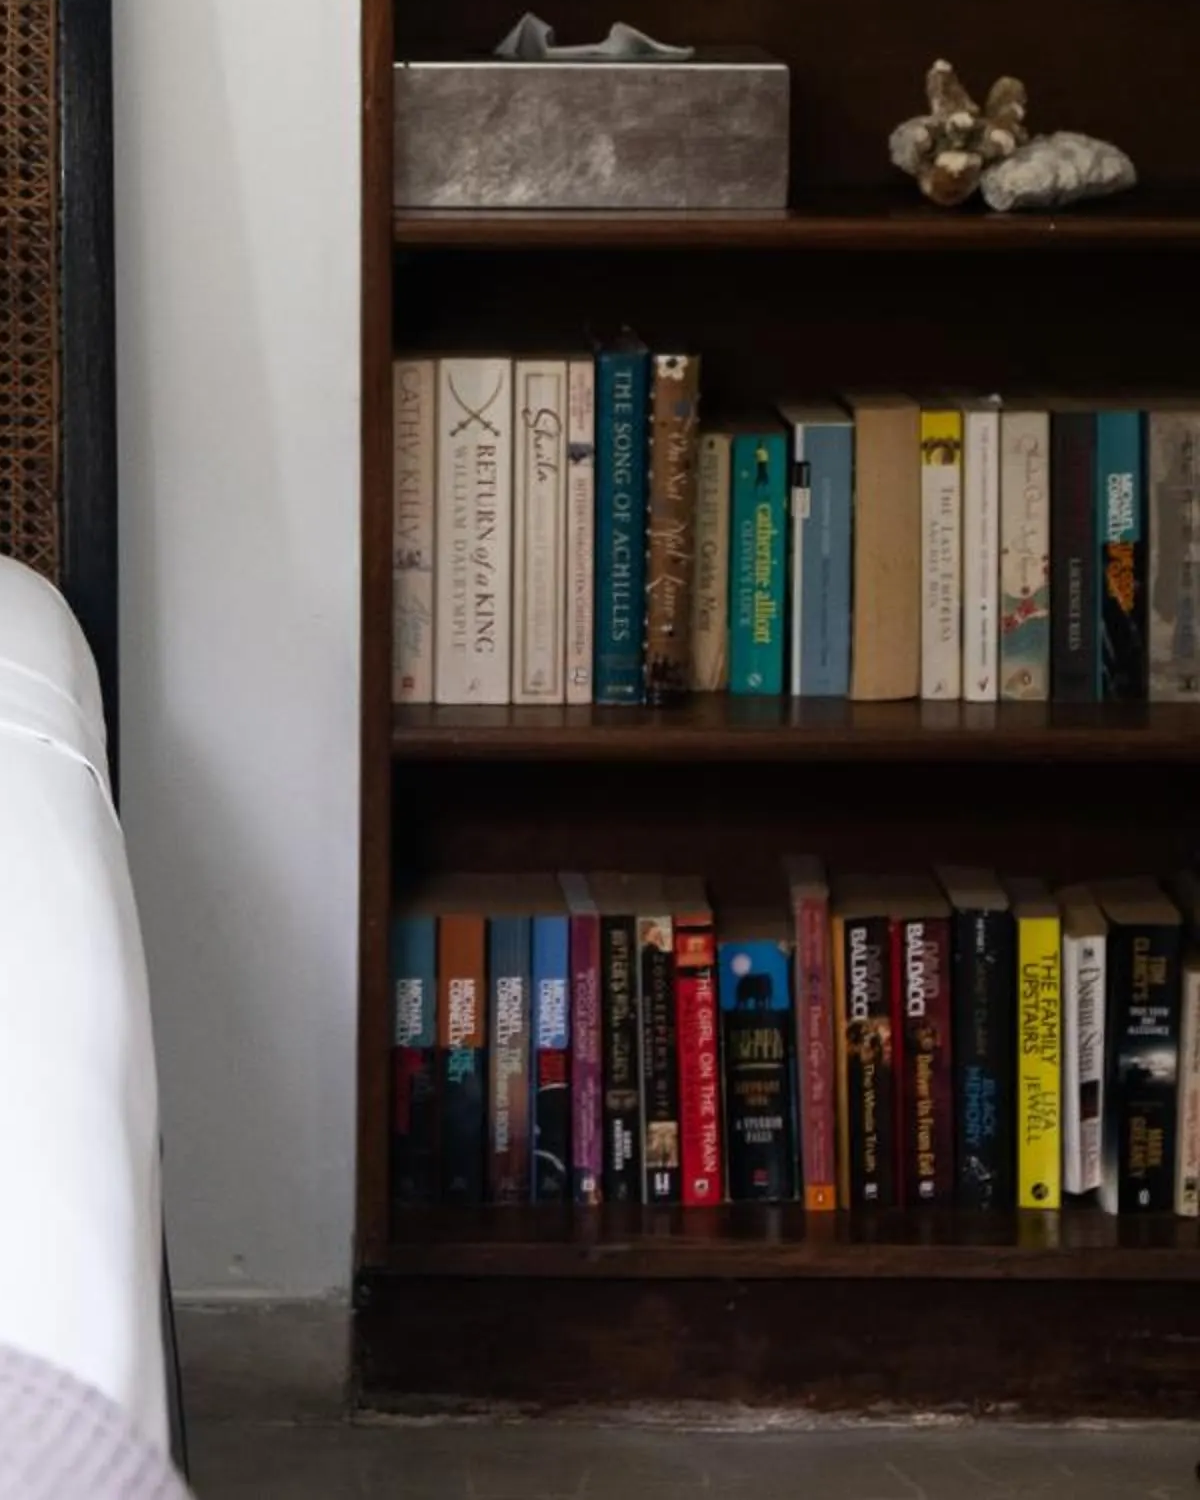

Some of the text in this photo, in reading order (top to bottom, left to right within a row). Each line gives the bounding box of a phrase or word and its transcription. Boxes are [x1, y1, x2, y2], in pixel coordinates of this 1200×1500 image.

[613, 369, 632, 414] THE
[521, 407, 563, 484] Sheila
[612, 422, 632, 484] SONG
[612, 493, 632, 522] OF
[755, 502, 779, 588] catherine
[452, 445, 468, 651] WILLIAM DALRYMPLE
[470, 444, 497, 655] RETURN of a KING
[611, 528, 631, 642] ACHILLES
[461, 978, 475, 1035] MICHAEL
[849, 927, 869, 1021] BALDACCI
[905, 922, 926, 1017] BALDACCI
[1039, 950, 1059, 1066] THE FAMILY
[447, 978, 462, 1048] CONNELLY
[1022, 962, 1041, 1055] UPSTAIRS
[695, 969, 718, 1174] THE GIRL ON THE TRAIN
[863, 1064, 876, 1087] The
[916, 1053, 934, 1096] Deliver
[965, 1065, 983, 1146] MEMORY
[917, 1118, 934, 1150] From
[1022, 1075, 1042, 1146] JEWELL
[1041, 1090, 1058, 1131] LISA
